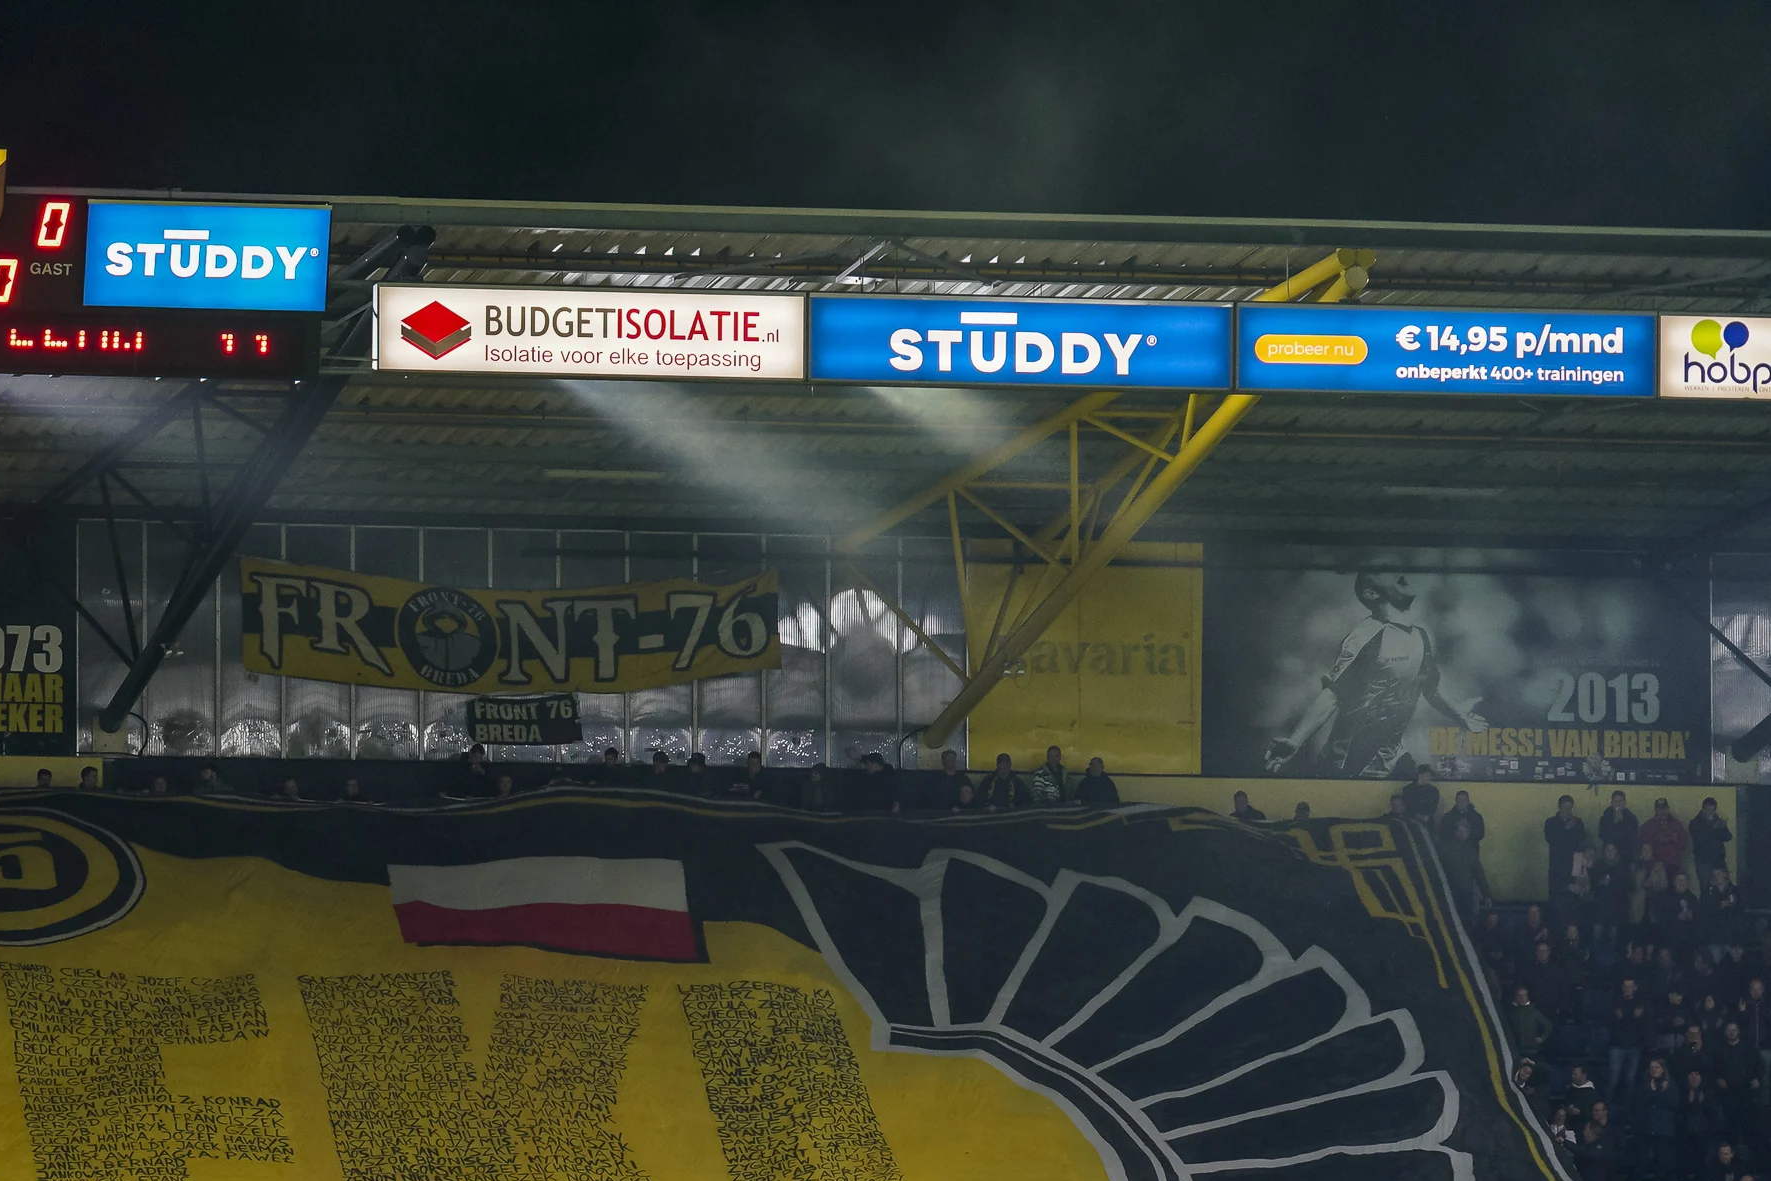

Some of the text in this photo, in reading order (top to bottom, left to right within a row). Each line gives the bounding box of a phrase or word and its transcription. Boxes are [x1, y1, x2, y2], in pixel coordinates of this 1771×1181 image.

[37, 202, 71, 247] 0
[29, 262, 73, 277] GAST
[484, 305, 780, 344] BUDGETISOLATIE.nl
[1267, 340, 1355, 359] probeer nu
[1396, 325, 1626, 359] € 14,95 p/mnd
[484, 345, 762, 372] Isolatie voor elke toepassing
[1396, 364, 1626, 385] onbeperkt 400+ trainingen
[1026, 632, 1189, 677] avaria
[475, 698, 573, 720] FRONT 76
[1548, 672, 1660, 723] 2013
[475, 724, 543, 743] BREDA
[1548, 729, 1599, 759] VAN
